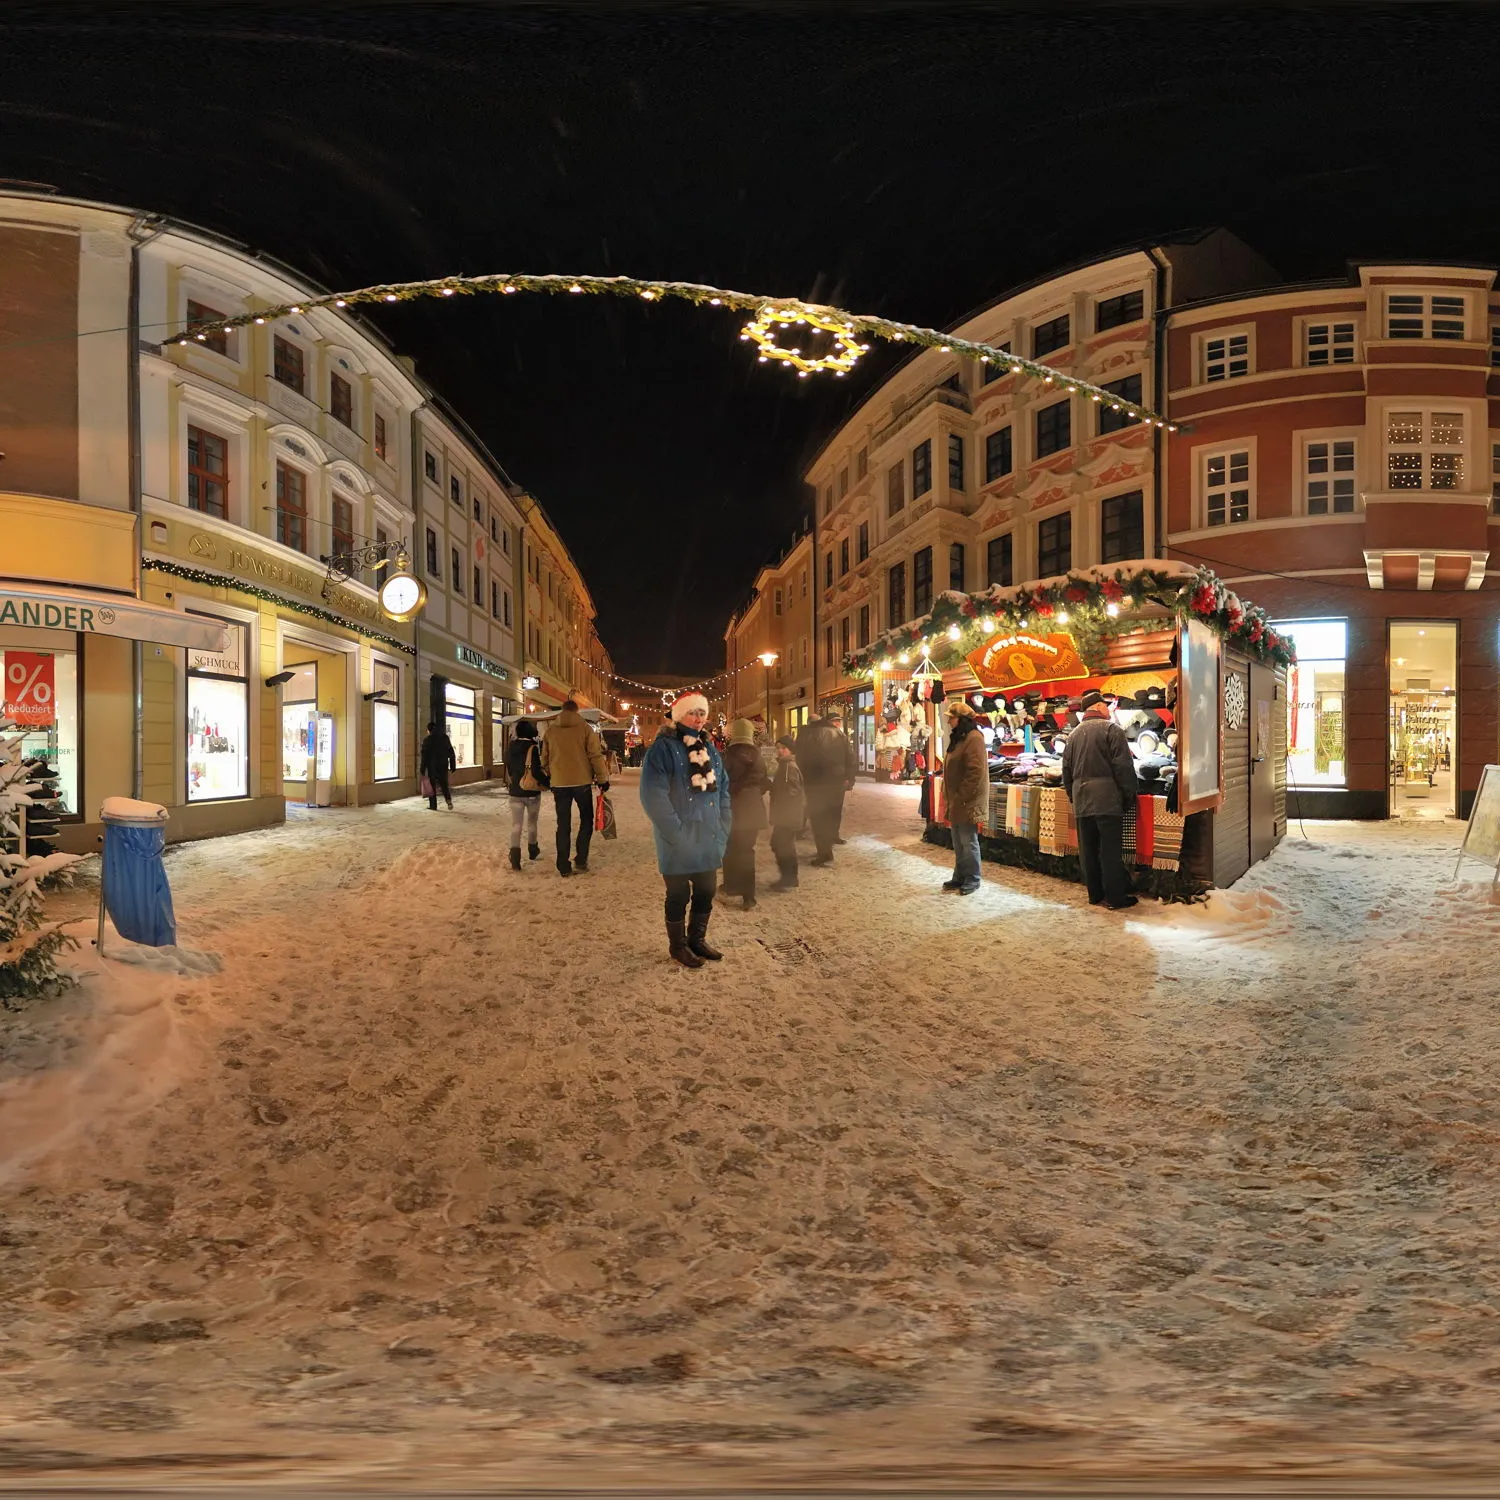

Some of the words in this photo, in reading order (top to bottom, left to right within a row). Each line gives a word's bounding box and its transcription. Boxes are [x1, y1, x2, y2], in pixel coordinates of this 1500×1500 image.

[226, 550, 313, 594] JUWELIER
[0, 600, 95, 631] ANDER
[194, 655, 240, 671] SCHMUCK
[463, 646, 483, 666] KIND
[8, 703, 51, 713] Reduziert
